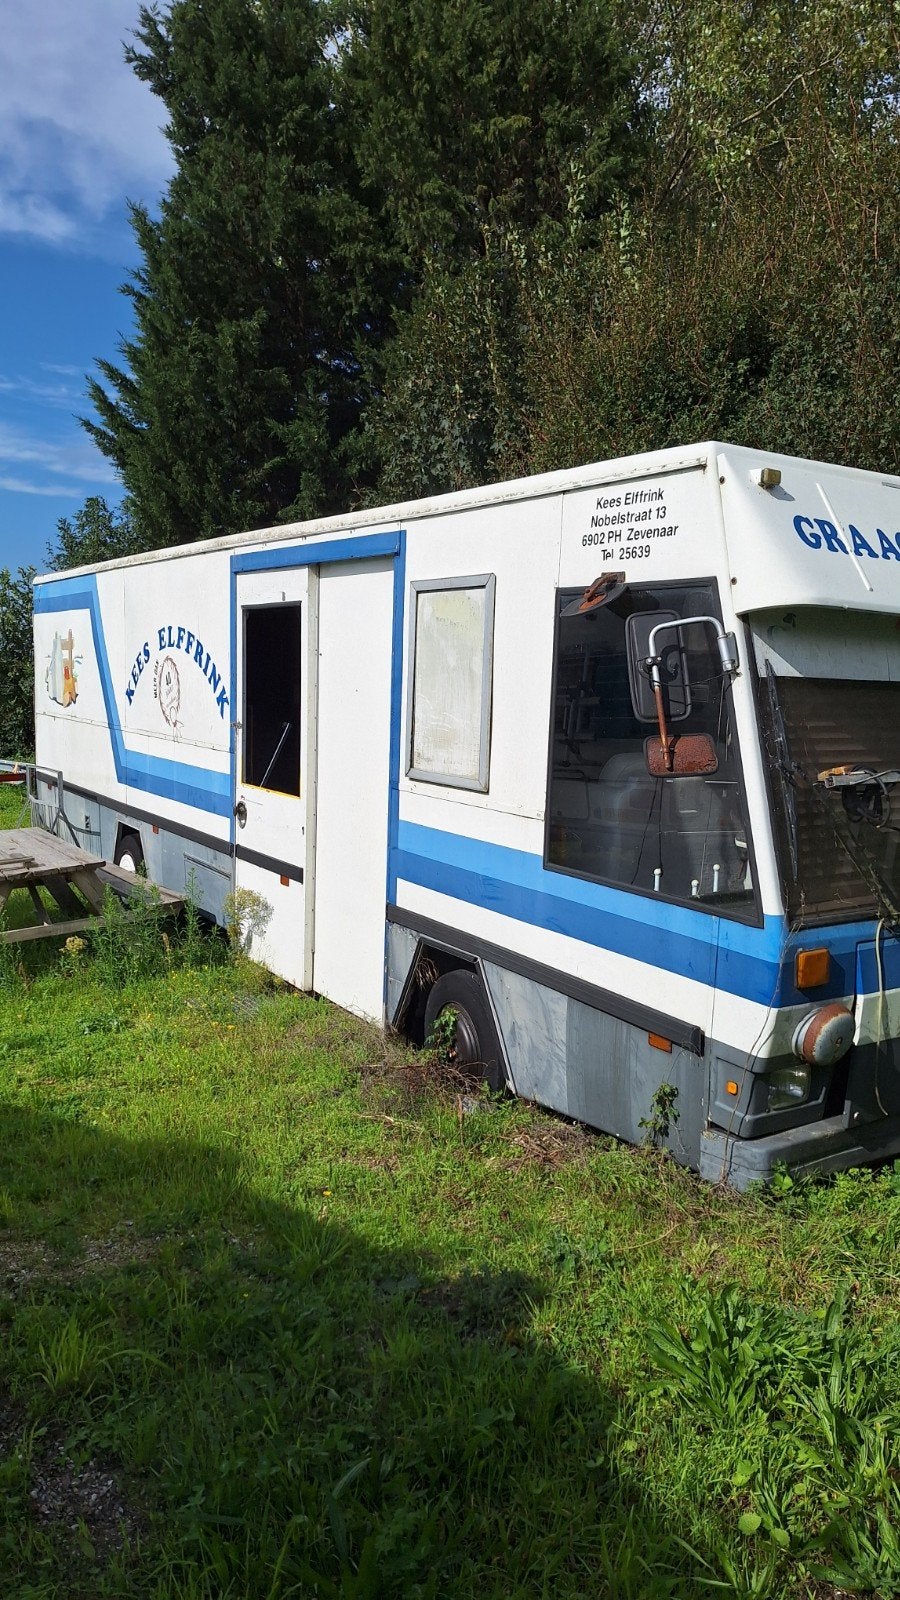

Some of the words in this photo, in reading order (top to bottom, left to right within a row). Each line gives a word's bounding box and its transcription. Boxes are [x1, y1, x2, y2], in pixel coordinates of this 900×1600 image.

[596, 497, 621, 510] Kees
[624, 488, 665, 505] Elffrink
[590, 508, 652, 528] Nobelstraat
[655, 506, 667, 520] 13
[582, 532, 605, 546] 6902
[607, 530, 622, 543] PH
[626, 525, 679, 541] Zevenaar
[793, 515, 900, 561] GRAA
[601, 549, 614, 561] Tel
[619, 545, 651, 560] 25639
[125, 642, 151, 706] KEES
[158, 625, 230, 720] ELFFRINK
